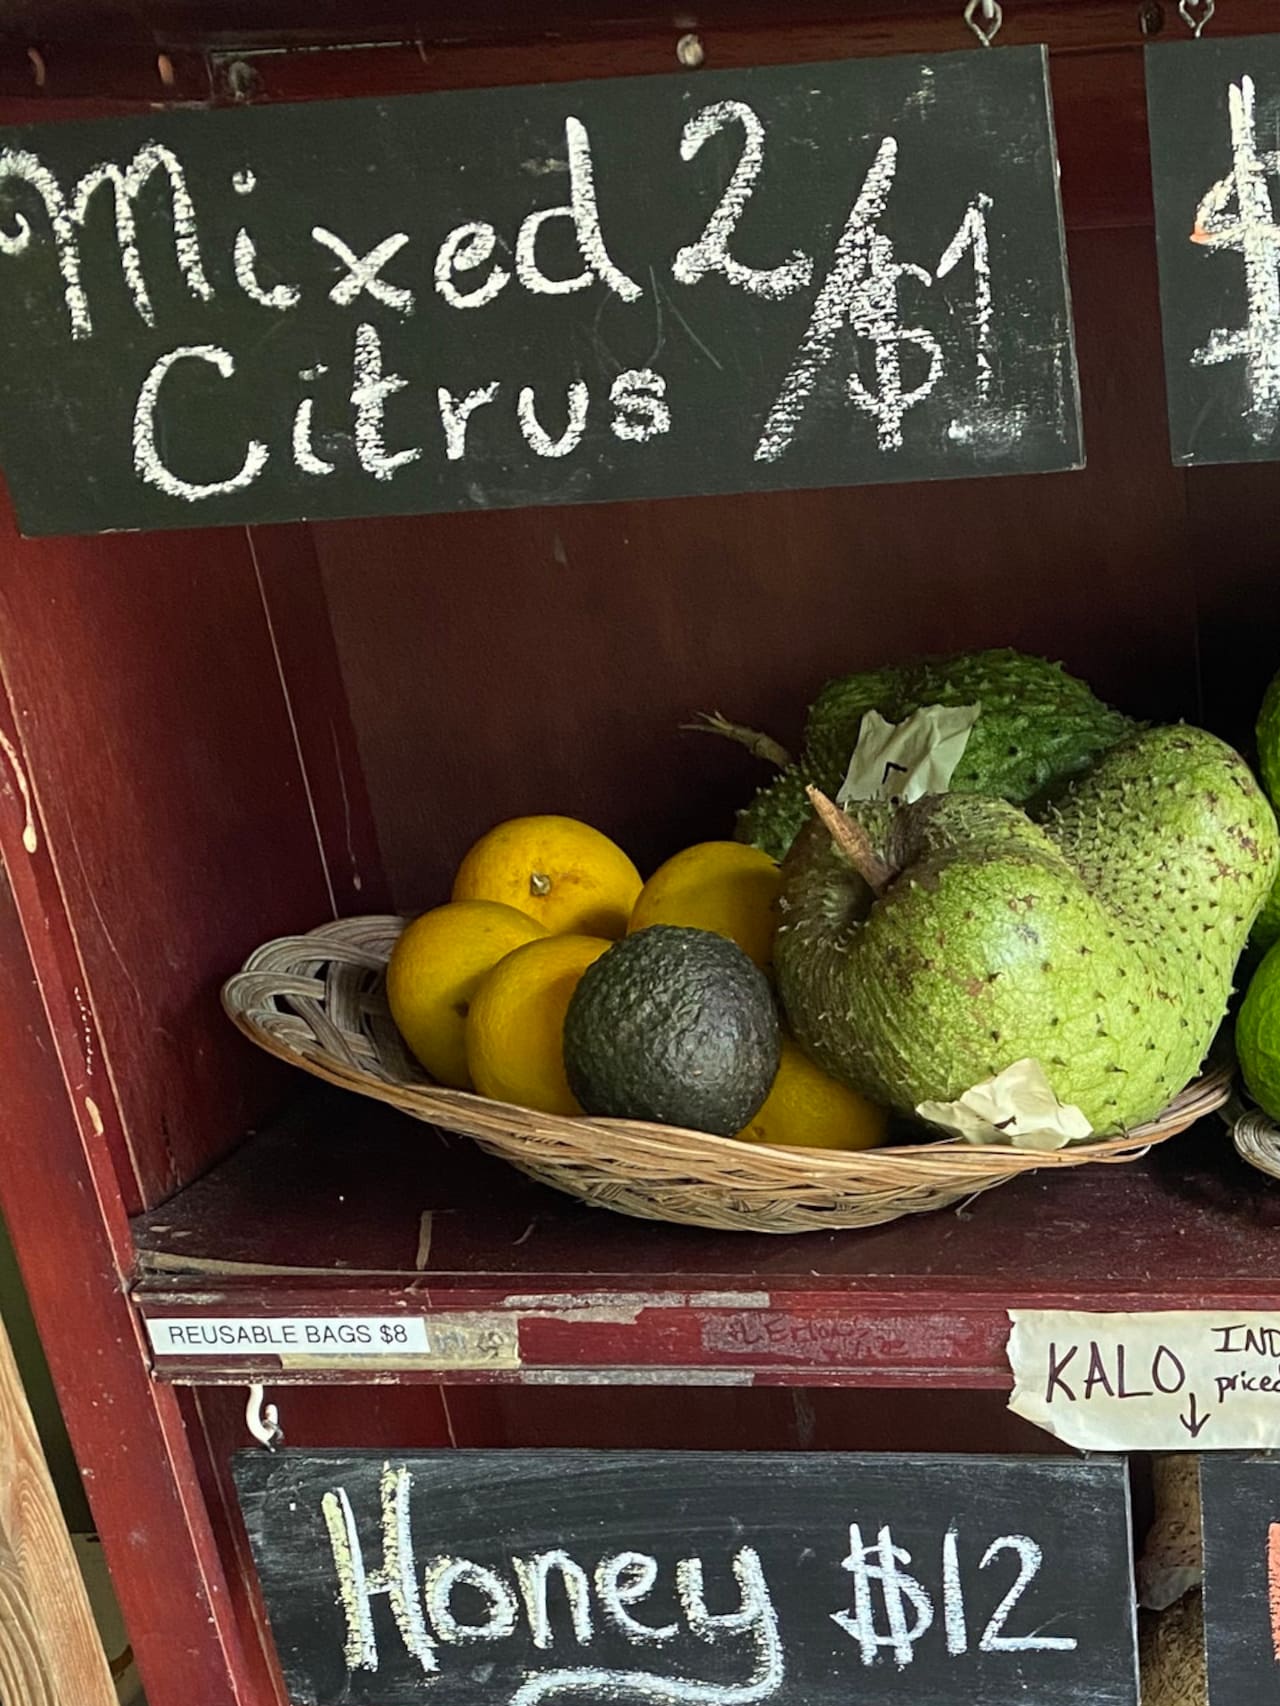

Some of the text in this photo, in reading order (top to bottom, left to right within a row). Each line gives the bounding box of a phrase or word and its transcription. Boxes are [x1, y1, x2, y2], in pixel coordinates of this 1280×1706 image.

[0, 116, 644, 341] Mixed
[132, 323, 672, 501] Citrus
[168, 1324, 408, 1344] REUSABLE BAGS $8
[1046, 1341, 1186, 1403] KALO
[829, 1522, 1079, 1671] $12
